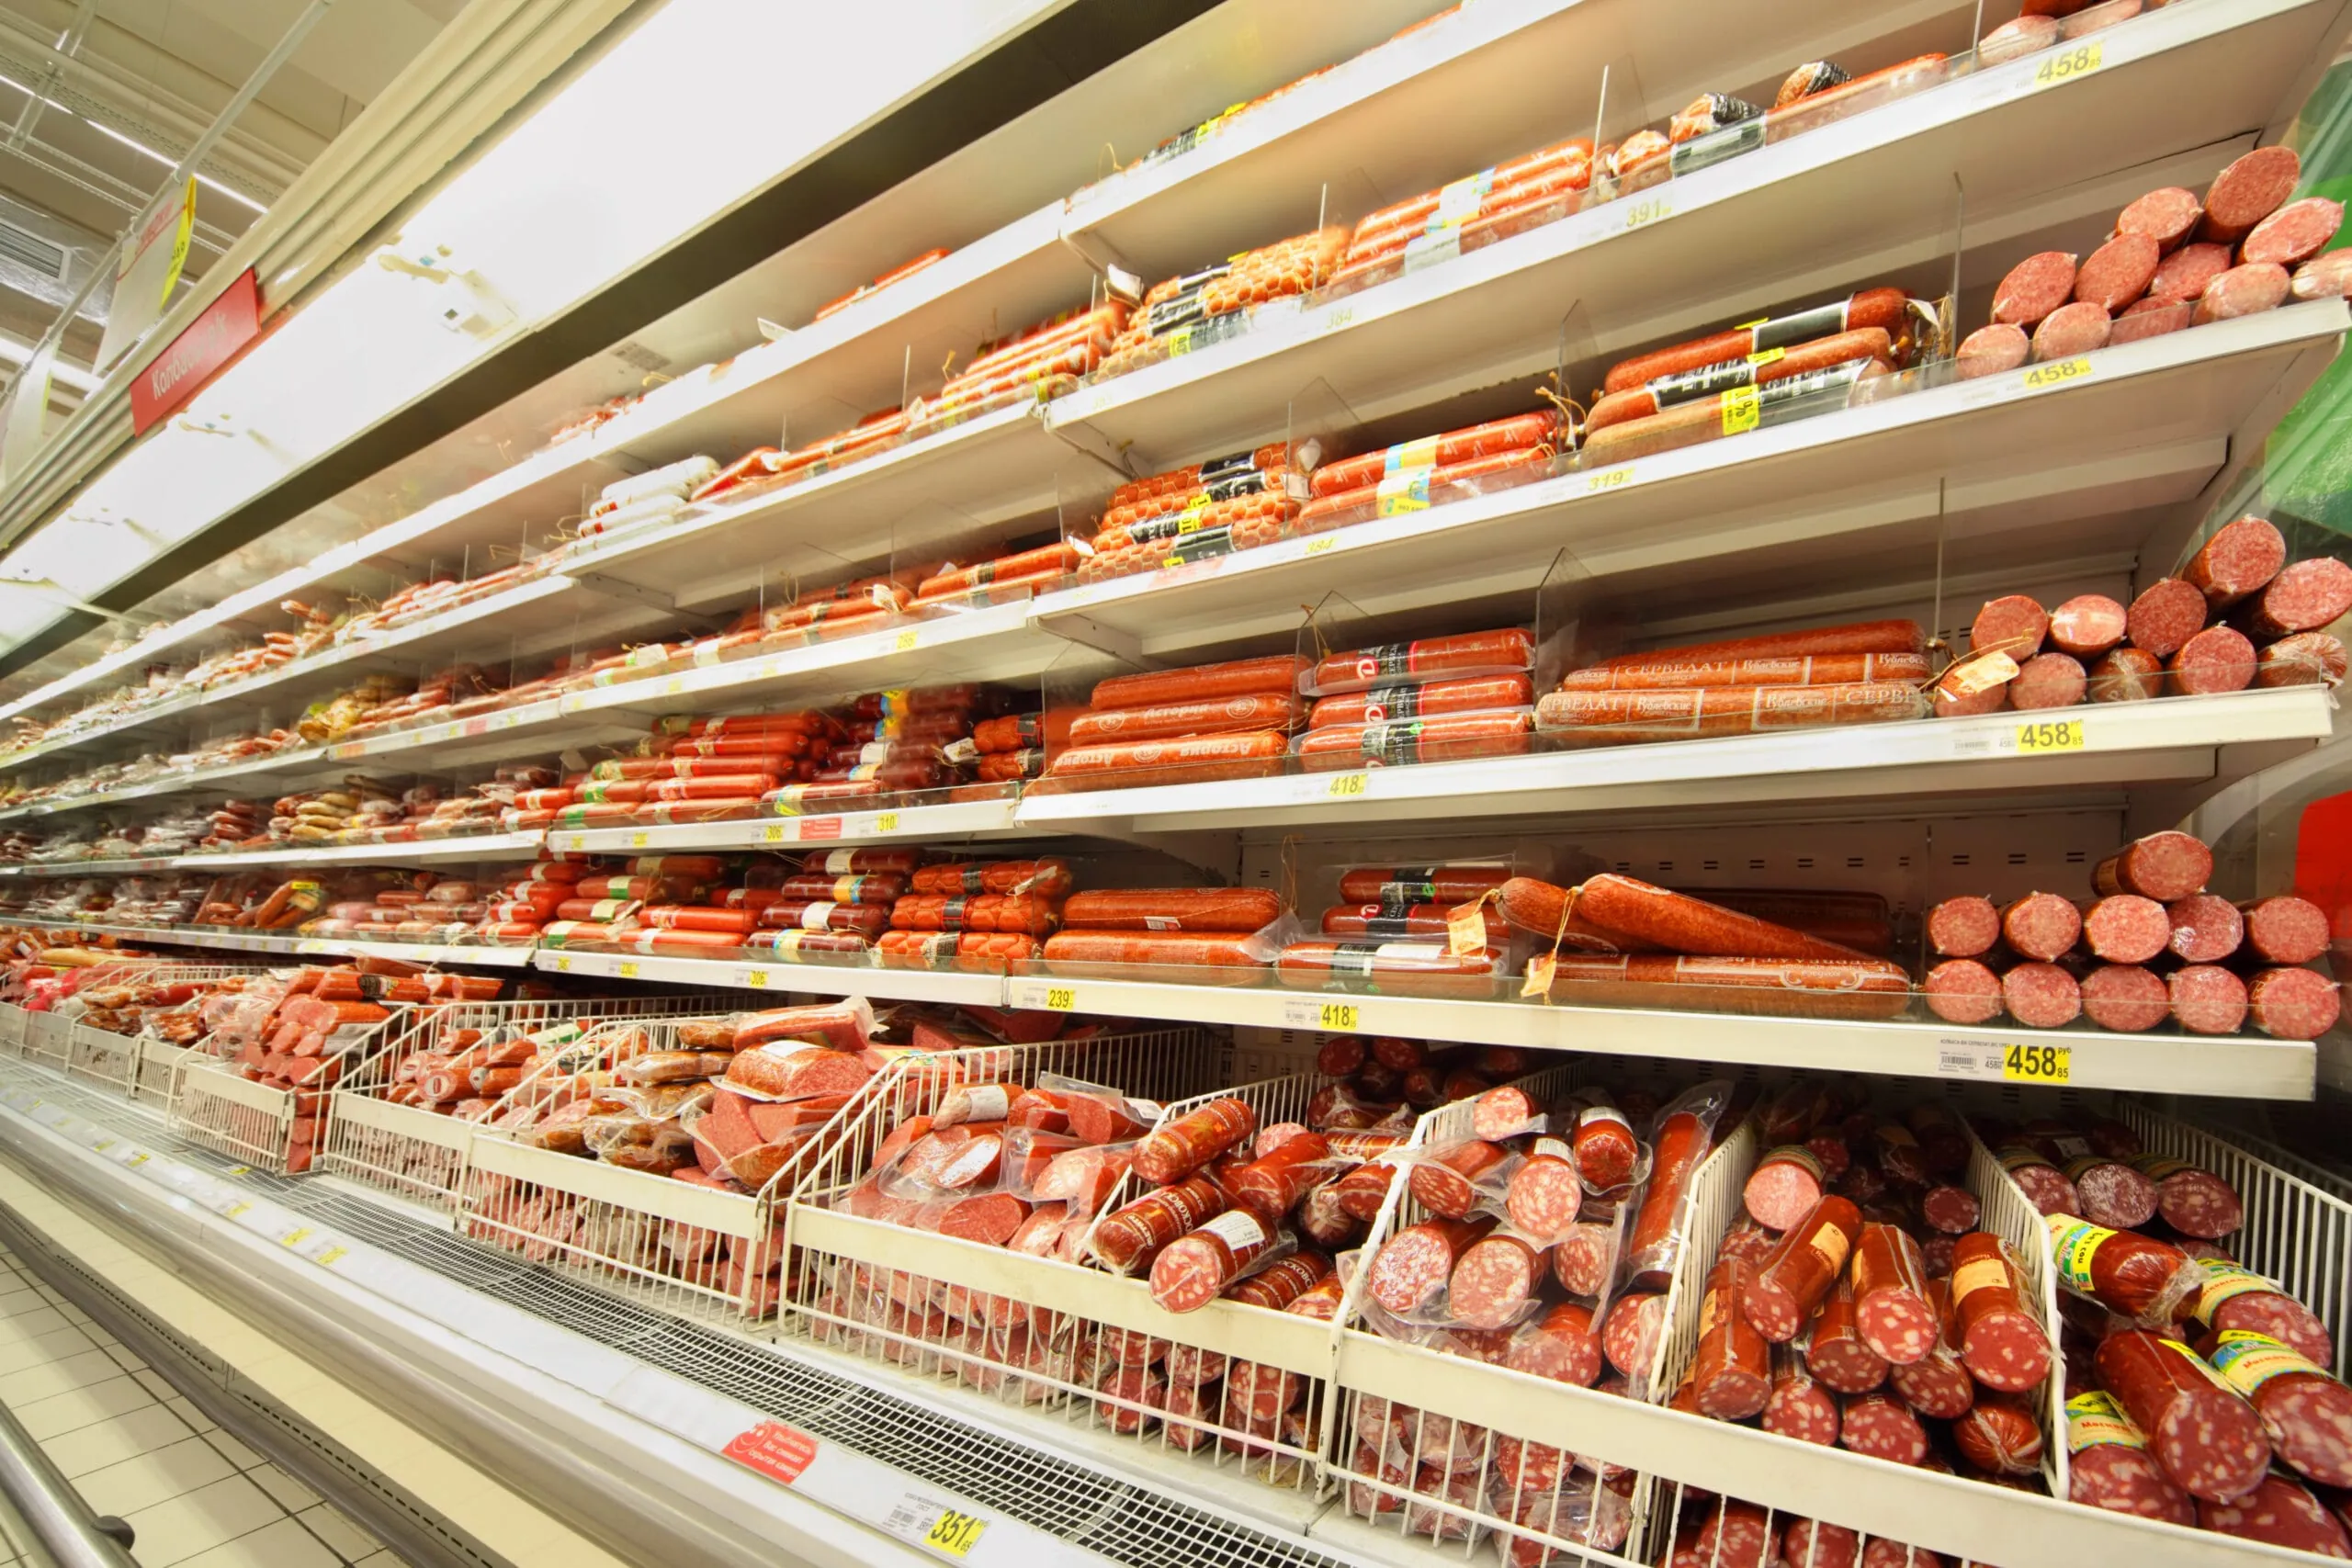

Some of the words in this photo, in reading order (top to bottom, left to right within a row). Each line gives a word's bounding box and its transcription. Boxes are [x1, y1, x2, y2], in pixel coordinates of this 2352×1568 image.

[2037, 47, 2089, 82] 458
[1625, 197, 1661, 227] 391
[2028, 362, 2077, 386] 458
[1588, 471, 1624, 492] 319
[1624, 660, 1728, 677] СЕРВЕЛАТ
[2020, 723, 2070, 749] 458
[2073, 738, 2083, 747] 85
[1329, 775, 1360, 795] 418
[1048, 989, 1070, 1009] 239
[1321, 1004, 1351, 1027] 418
[2007, 1044, 2057, 1077] 458
[2058, 1047, 2073, 1055] руб
[2058, 1068, 2070, 1079] 85
[931, 1509, 978, 1549] 351
